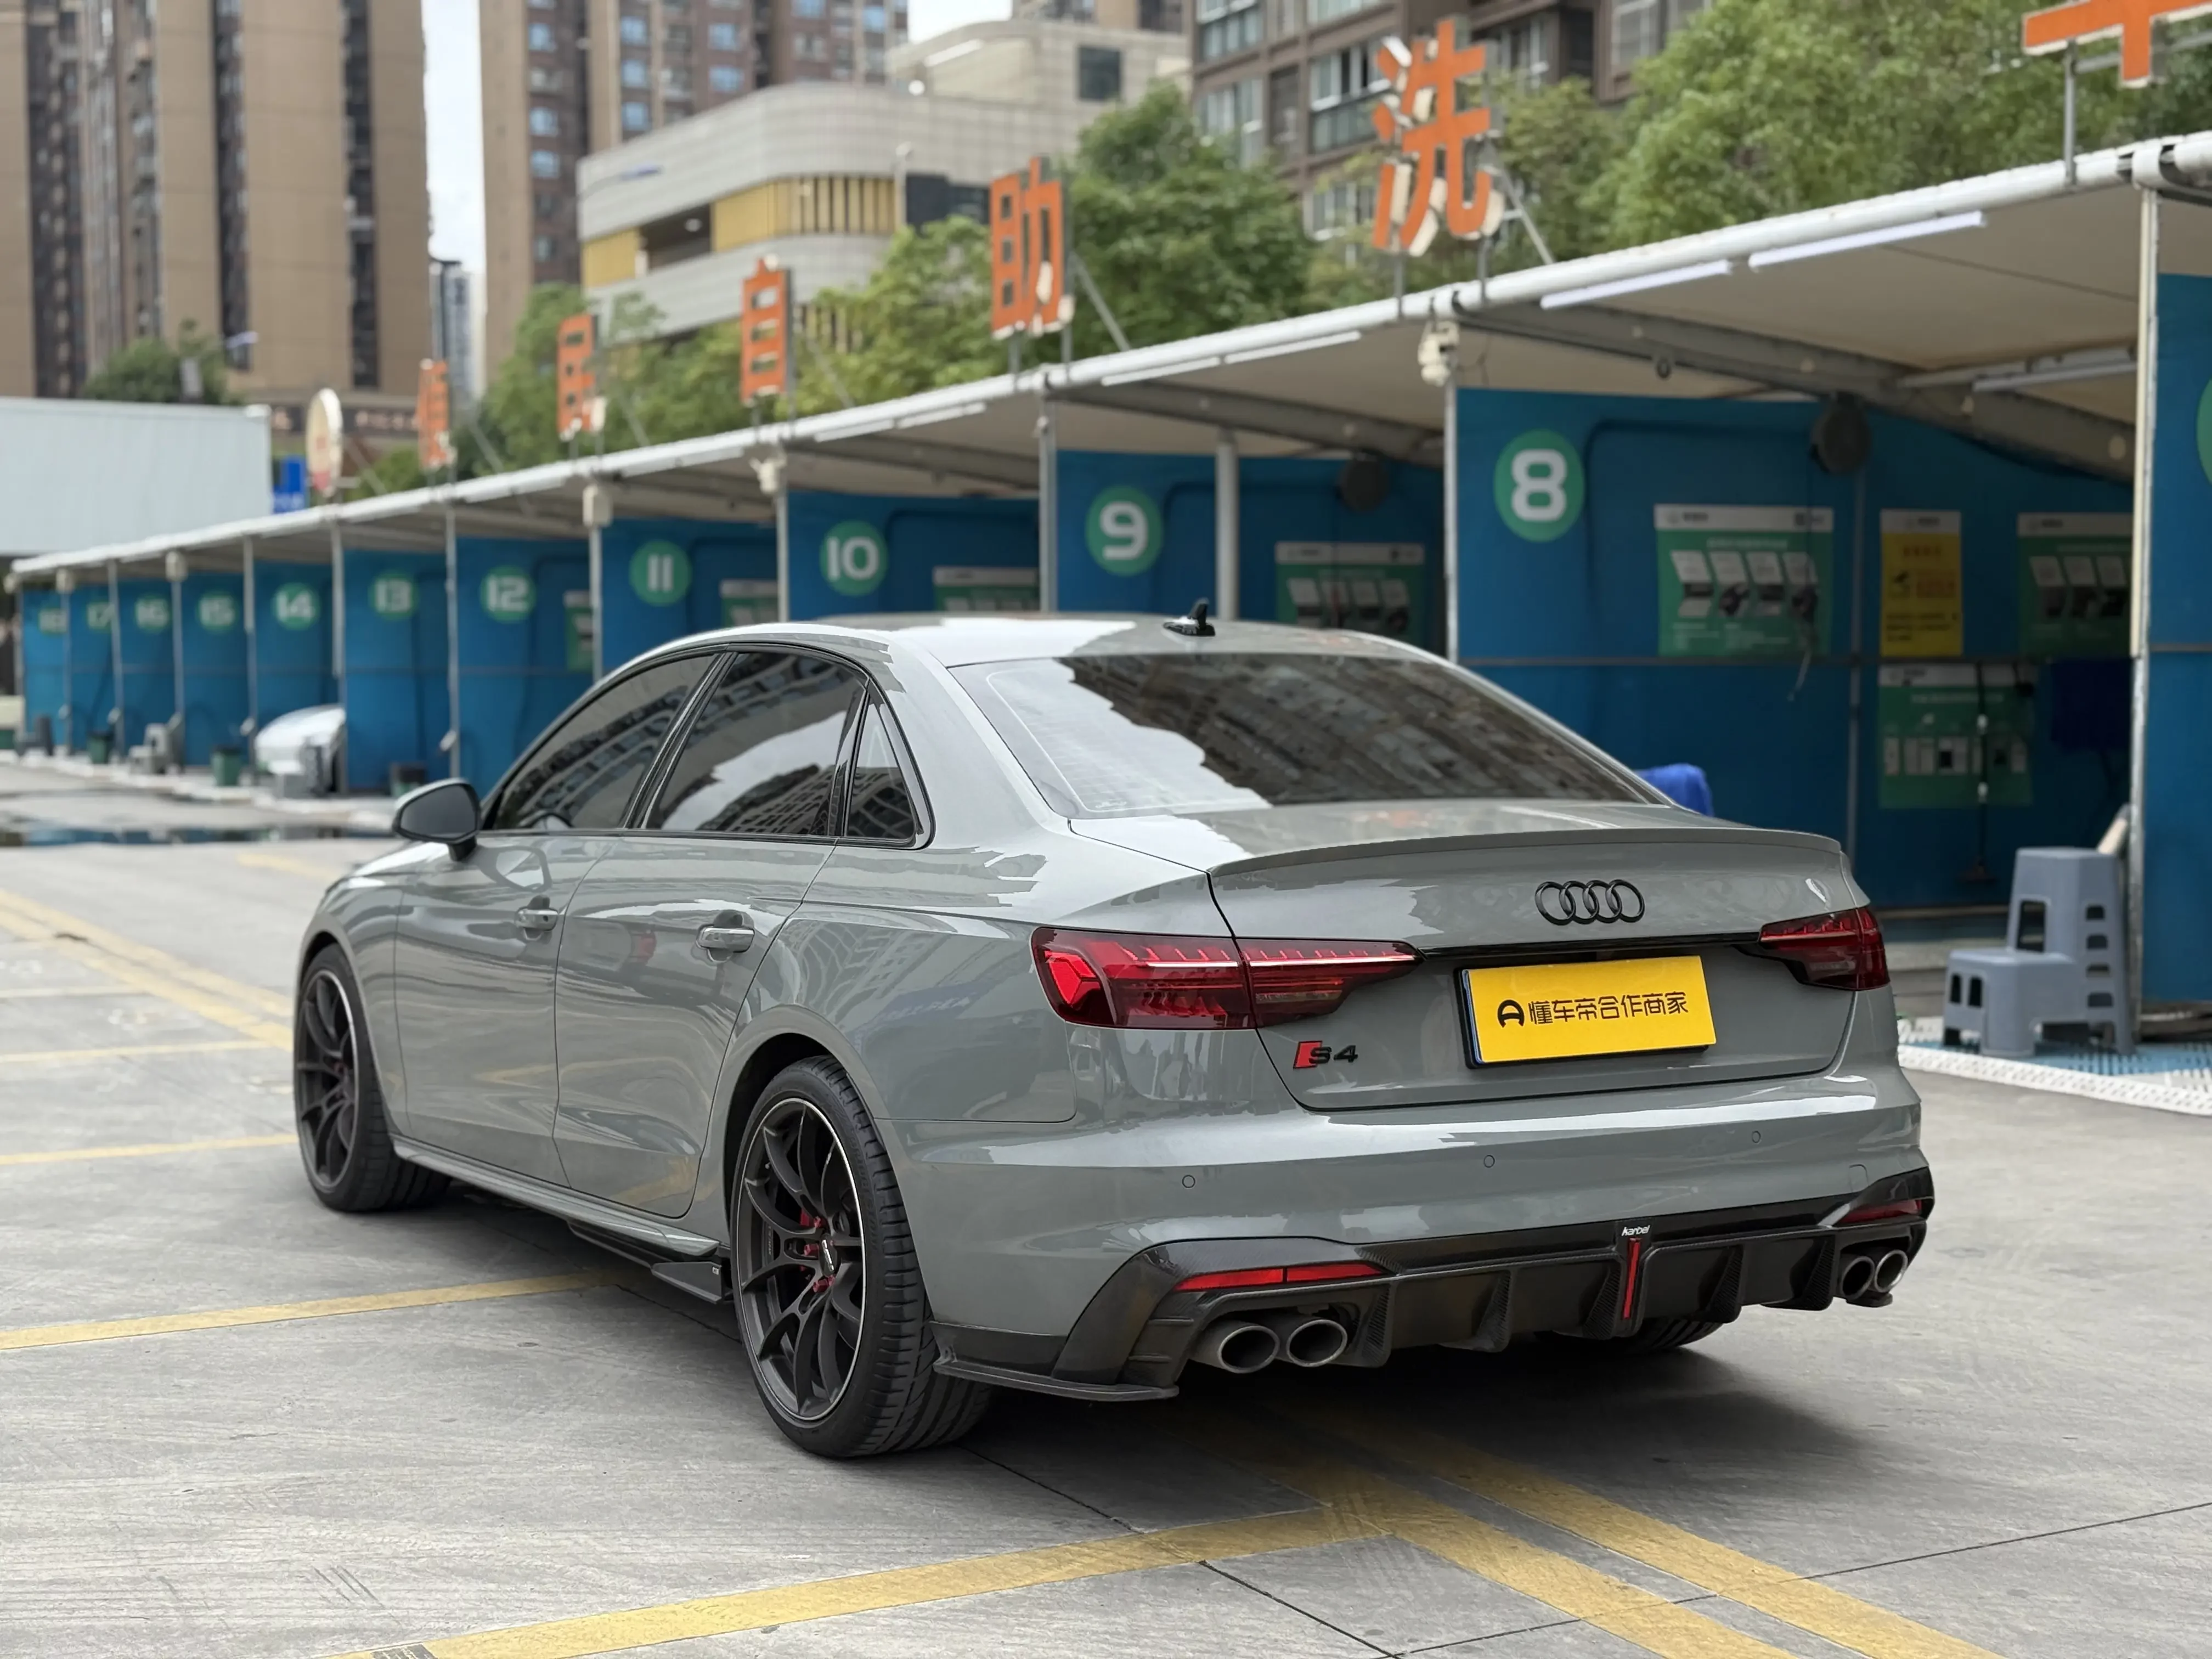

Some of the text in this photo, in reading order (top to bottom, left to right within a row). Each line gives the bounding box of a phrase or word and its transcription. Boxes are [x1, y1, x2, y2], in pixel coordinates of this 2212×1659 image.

[991, 156, 1062, 332] 助
[1372, 19, 1492, 250] 洗
[1510, 448, 1567, 522] 8
[1099, 500, 1149, 561] 9
[647, 554, 674, 591] 11
[826, 537, 879, 580] 10
[276, 591, 313, 622] 14
[375, 578, 412, 613] 13
[485, 575, 529, 612] 12
[1528, 991, 1688, 1025] 懂车帝合作商家
[1308, 1044, 1359, 1064] S4
